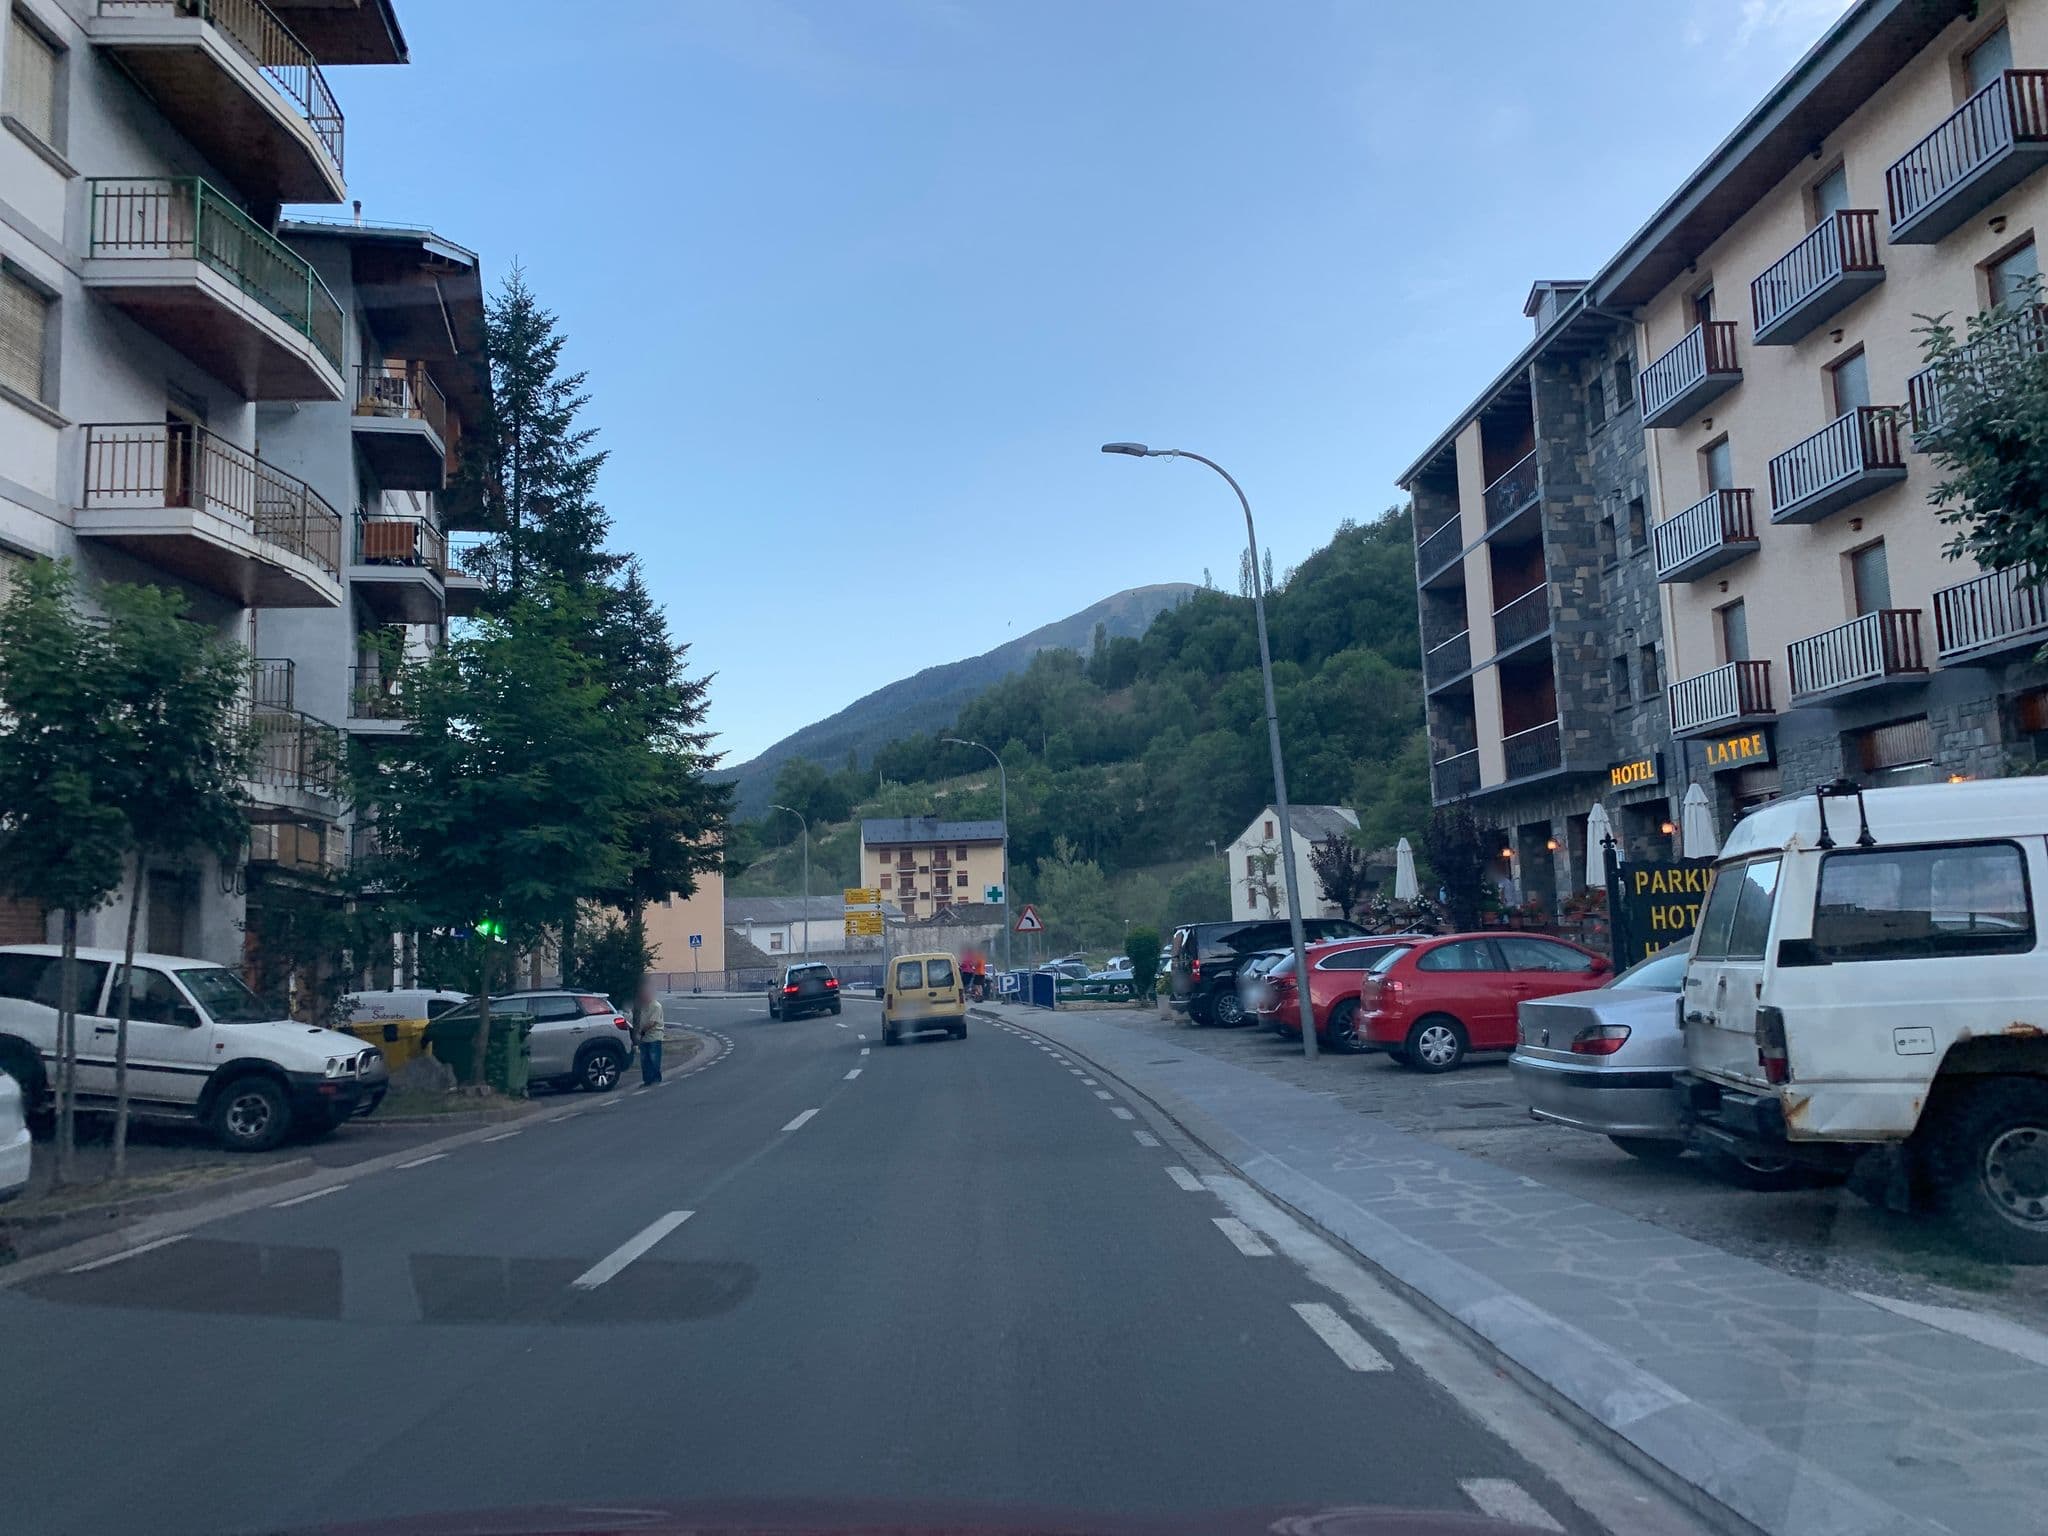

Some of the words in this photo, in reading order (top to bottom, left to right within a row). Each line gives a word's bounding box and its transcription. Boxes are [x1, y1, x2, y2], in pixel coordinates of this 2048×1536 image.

[1610, 760, 1655, 787] HOTEL
[1706, 733, 1763, 765] LATRE
[1002, 976, 1015, 991] P
